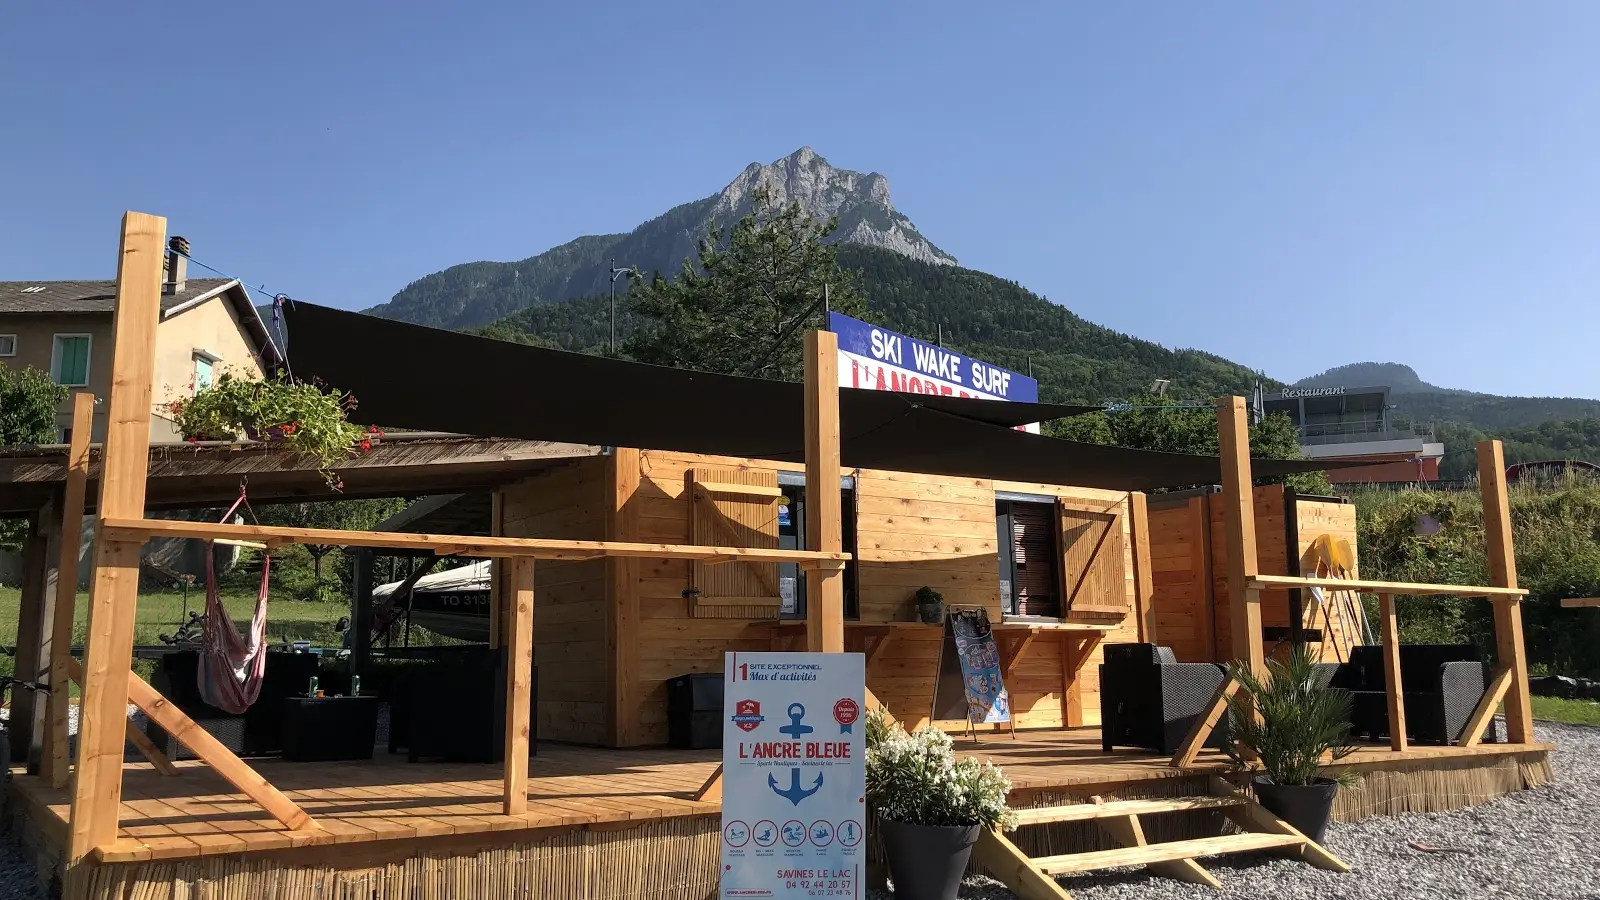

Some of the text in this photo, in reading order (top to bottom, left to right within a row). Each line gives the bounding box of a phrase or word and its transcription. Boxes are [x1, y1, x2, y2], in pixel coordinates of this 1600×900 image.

[870, 329, 1011, 396] SKI WAKE SURF
[1281, 386, 1345, 398] Restaurant
[739, 663, 748, 680] 1
[749, 671, 769, 681] Max
[739, 742, 851, 759] L'ANCRE BLEUE
[757, 760, 773, 768] Sports
[773, 760, 798, 768] Nautiques
[777, 869, 851, 879] SAVINES LE LAC
[786, 880, 851, 889] 04 92 44 20 57
